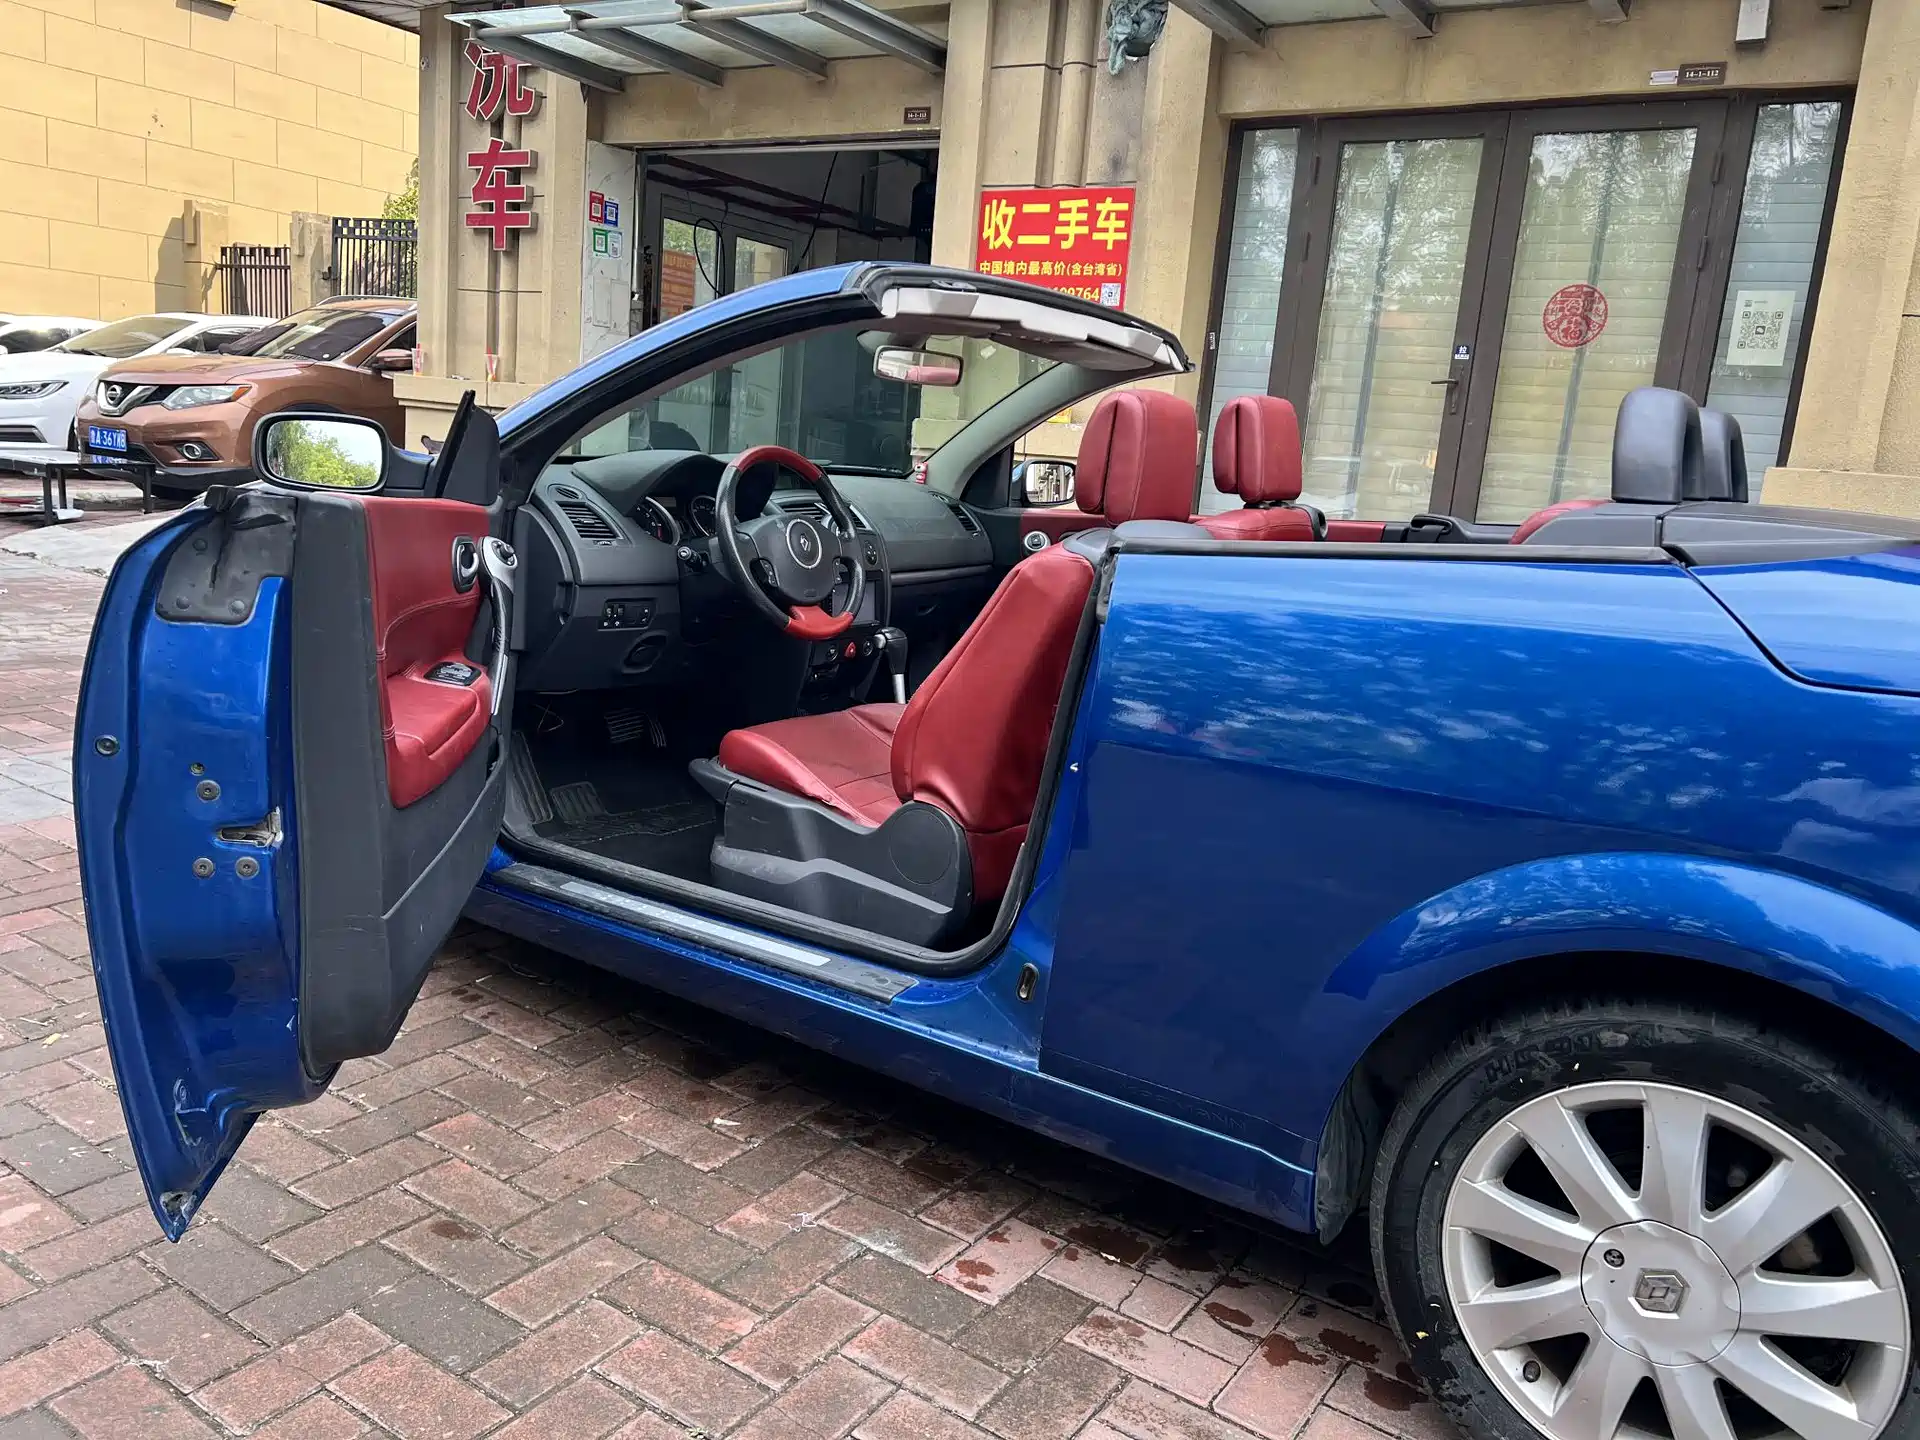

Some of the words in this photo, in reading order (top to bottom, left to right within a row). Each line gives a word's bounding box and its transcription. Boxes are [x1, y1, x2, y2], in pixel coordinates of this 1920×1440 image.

[464, 41, 537, 251] 洗车
[982, 197, 1129, 250] 收二手车
[979, 260, 1122, 276] 中国境内最高价(含台湾省)
